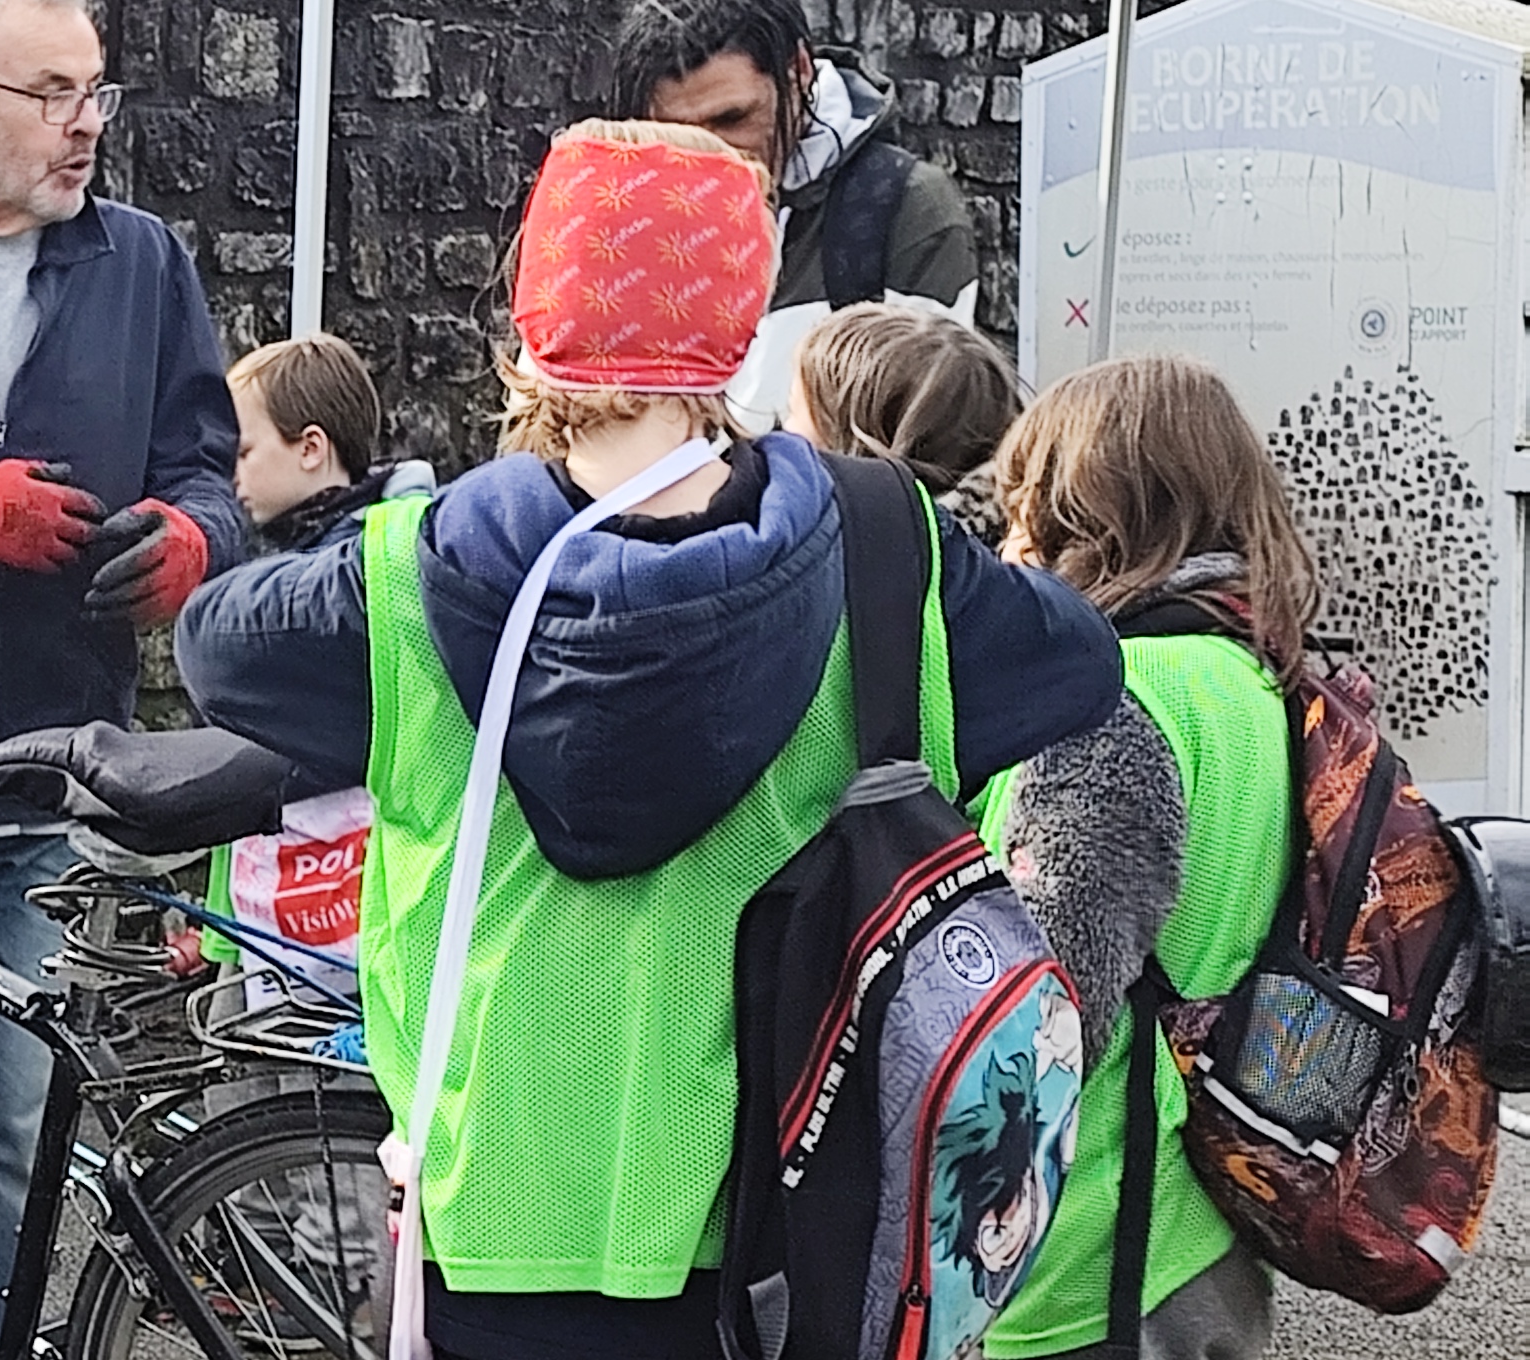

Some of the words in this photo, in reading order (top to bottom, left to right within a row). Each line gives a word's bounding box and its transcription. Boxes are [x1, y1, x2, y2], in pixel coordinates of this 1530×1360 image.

[1153, 44, 1303, 86] BORNE
[1321, 41, 1375, 81] DE
[1131, 85, 1440, 132] ECUPERATION
[1121, 227, 1181, 251] éposez
[1410, 306, 1468, 326] POINT
